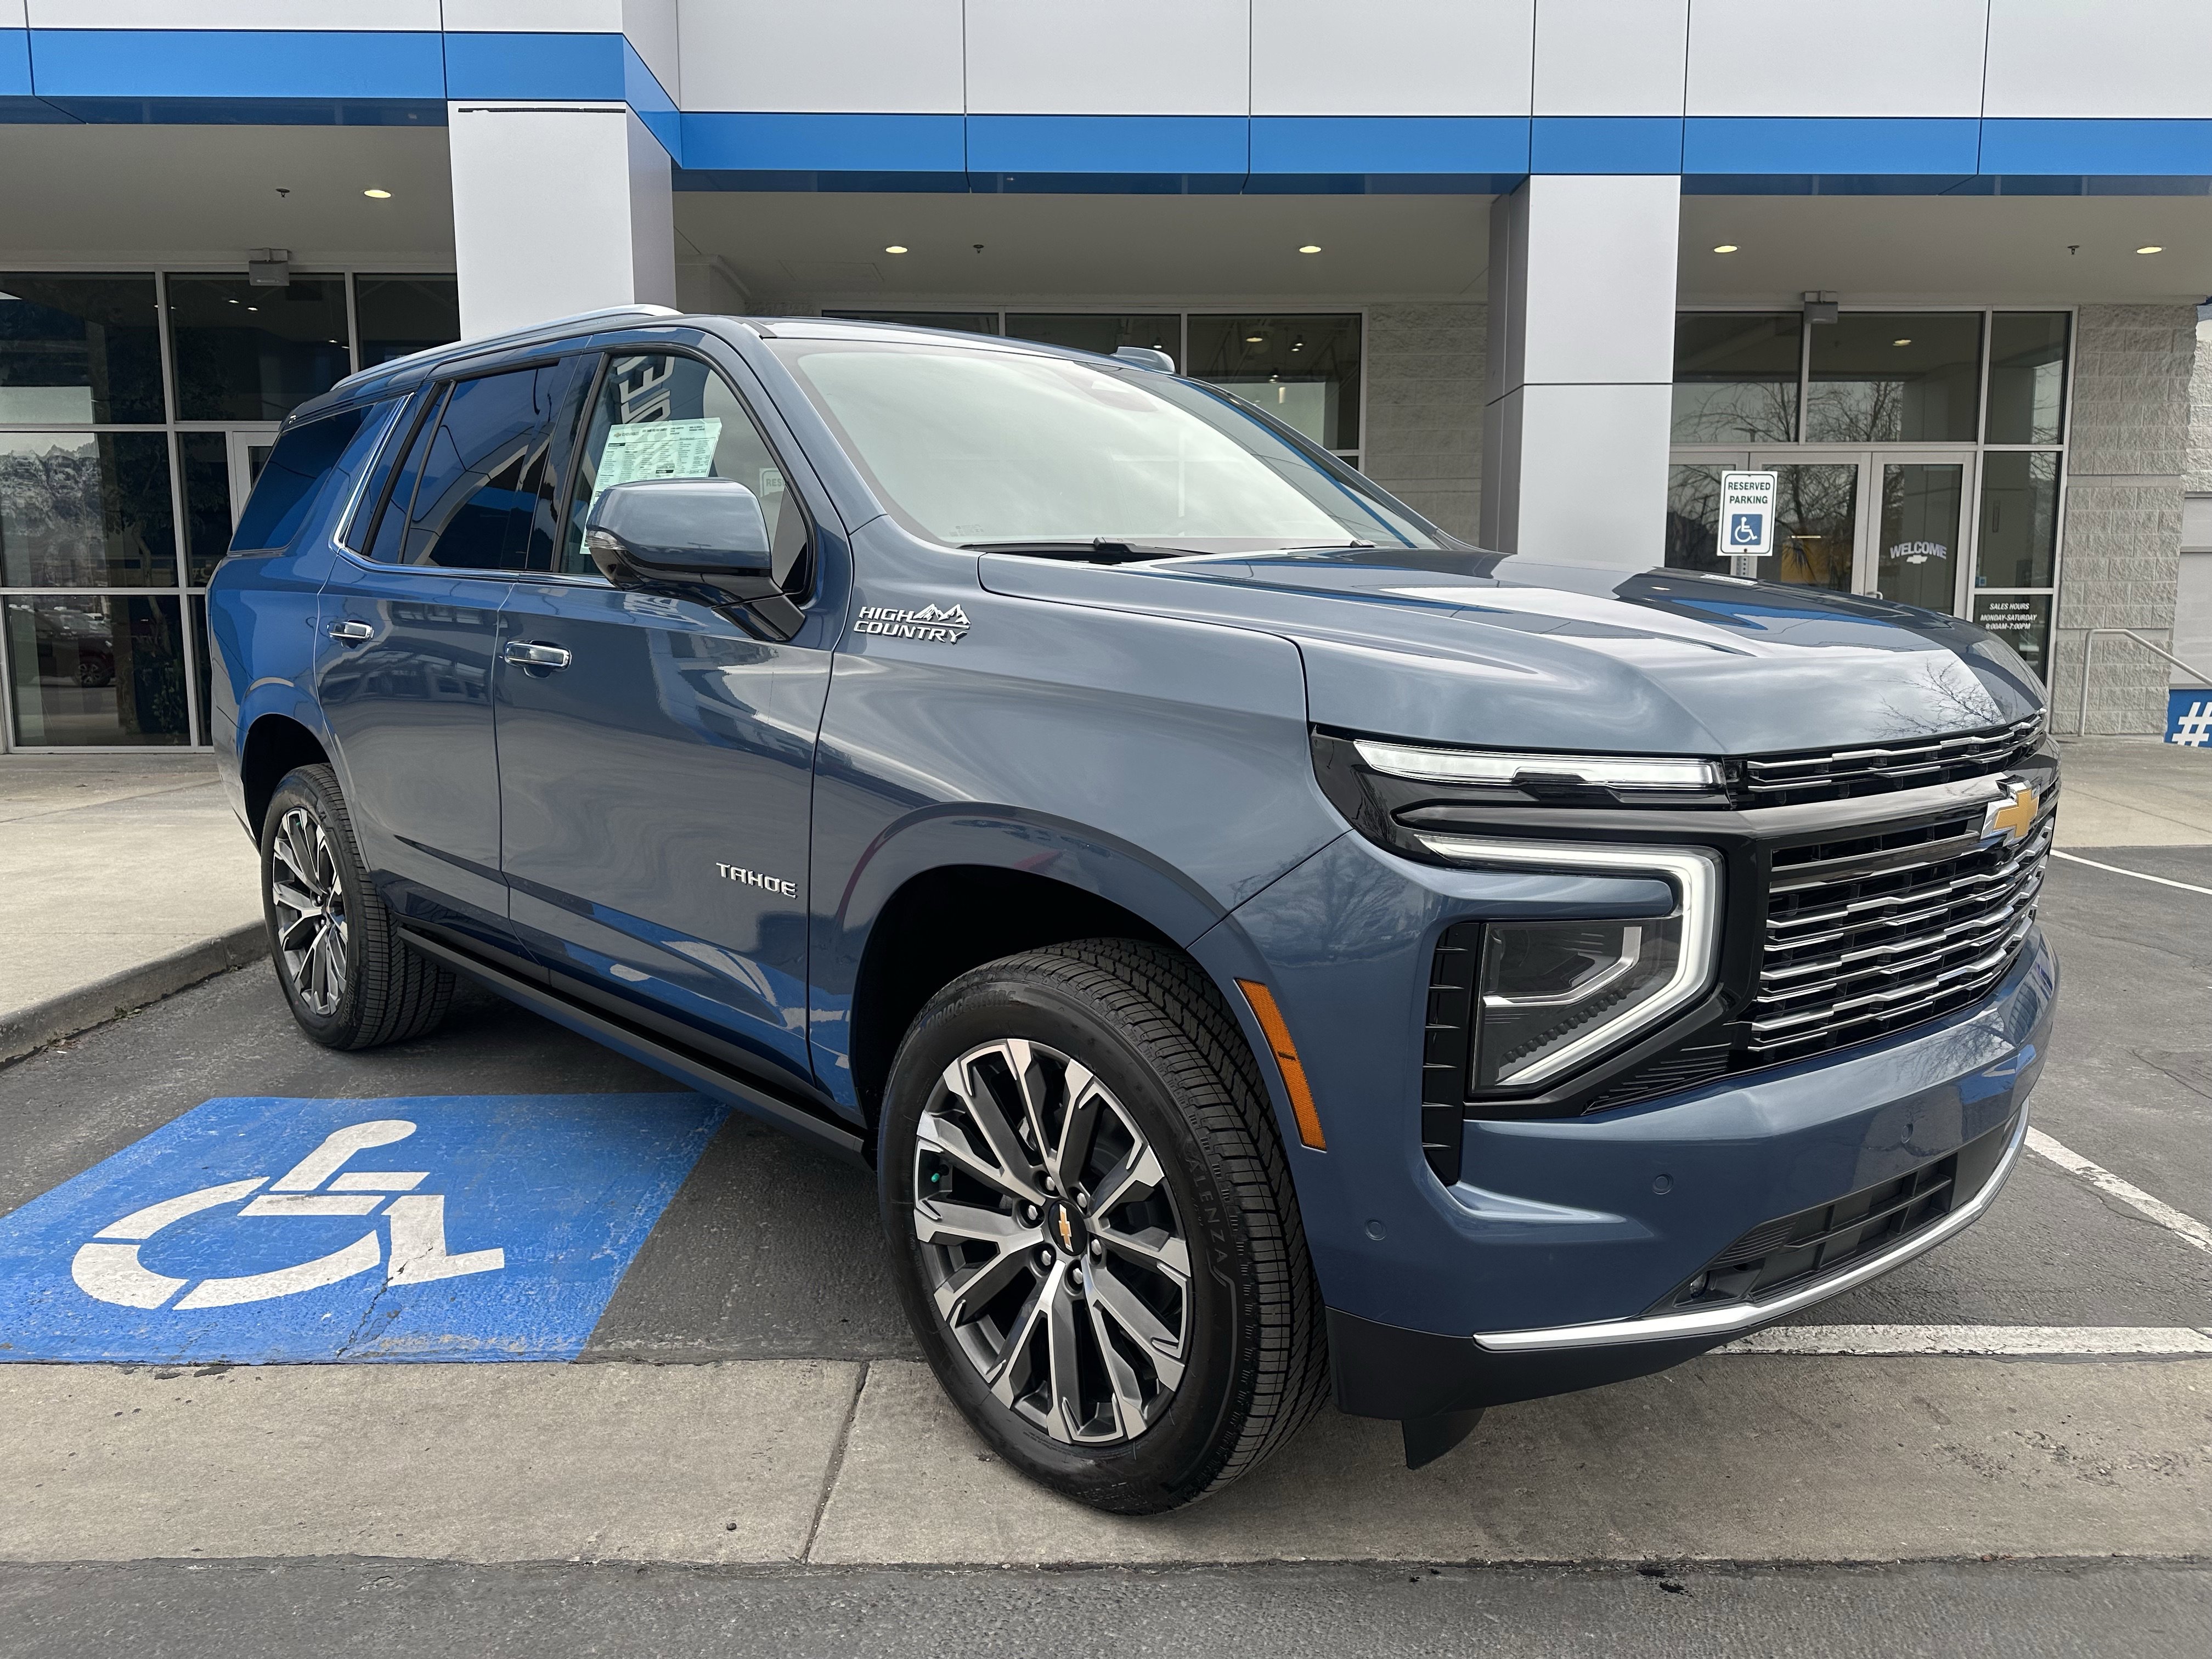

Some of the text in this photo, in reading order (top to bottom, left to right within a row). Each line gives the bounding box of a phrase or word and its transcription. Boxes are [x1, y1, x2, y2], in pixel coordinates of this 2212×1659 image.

[1728, 482, 1771, 490] RESERVED
[1729, 495, 1768, 504] PARKING
[1889, 541, 1947, 560] WELCOME
[858, 606, 915, 623] HIGH
[853, 620, 968, 645] COUNTRY
[715, 861, 797, 899] TAHOE
